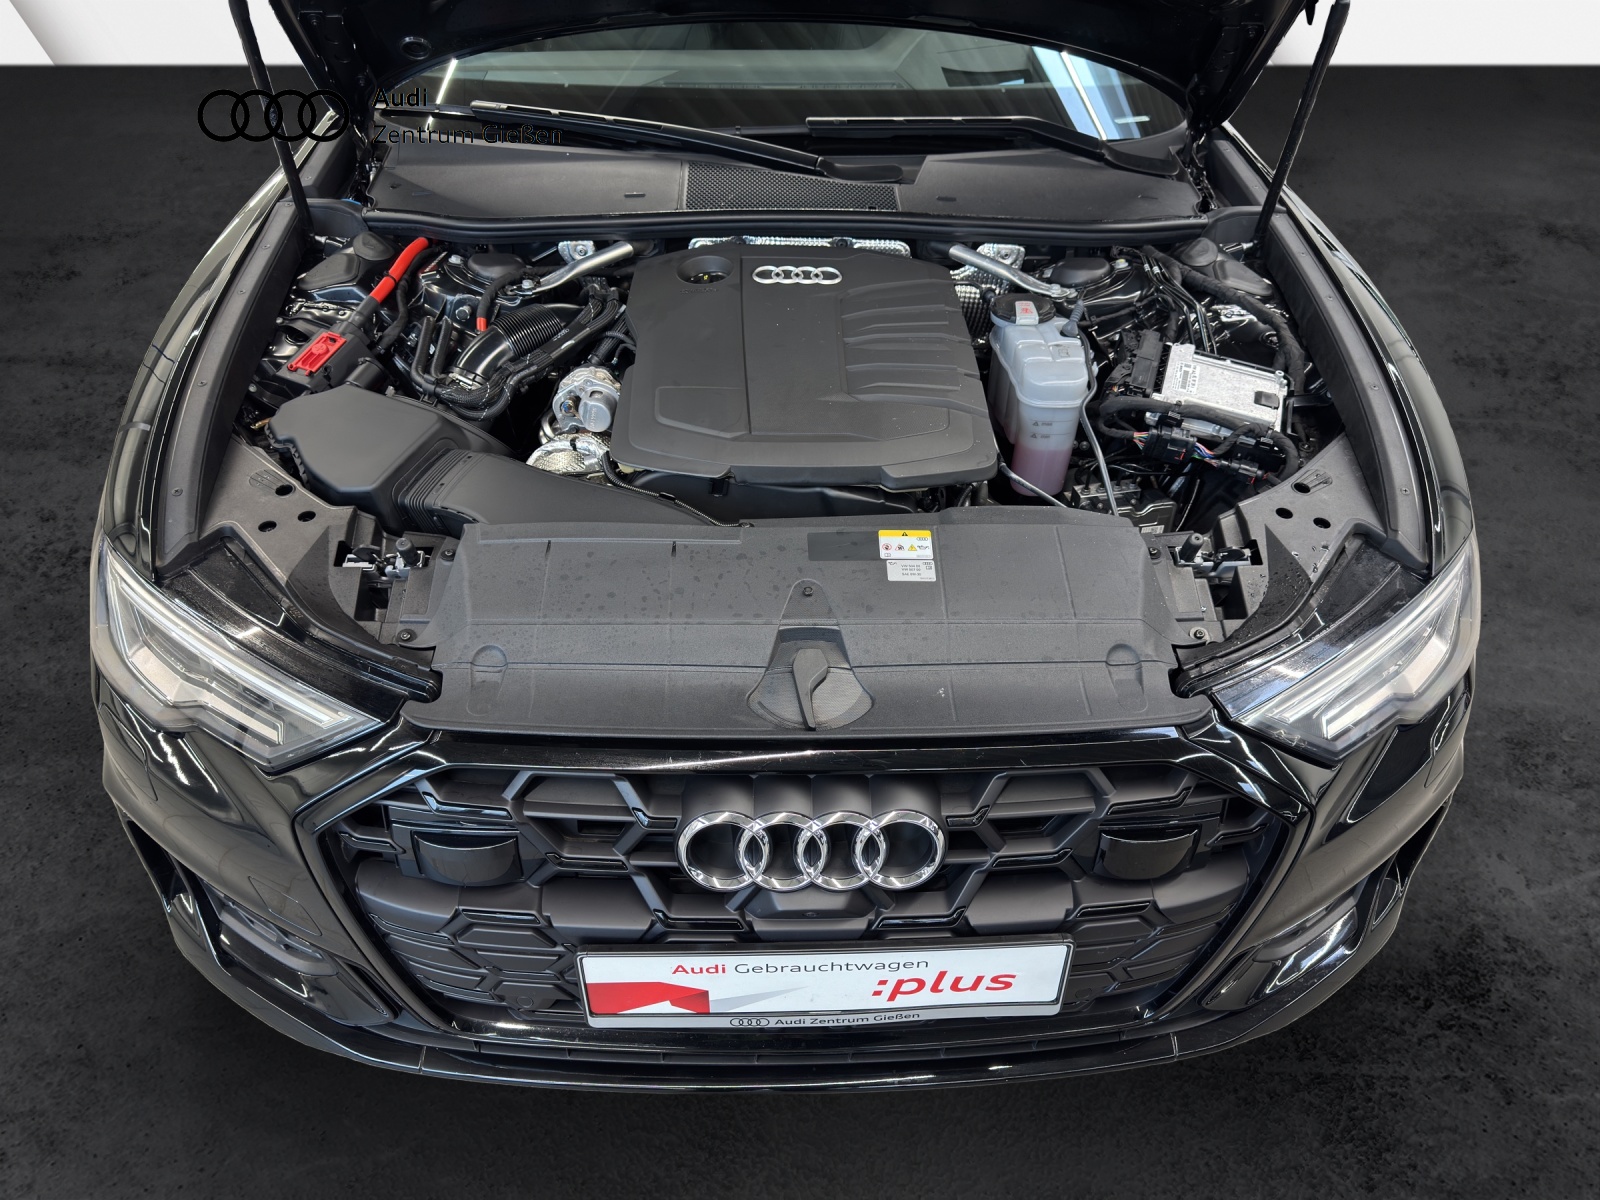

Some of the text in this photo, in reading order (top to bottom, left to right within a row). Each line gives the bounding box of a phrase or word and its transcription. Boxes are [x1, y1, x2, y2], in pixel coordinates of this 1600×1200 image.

[672, 960, 929, 975] Audi Gebrauchtwagen
[810, 1015, 869, 1024] Zentrum
[873, 1012, 920, 1022] Gießen
